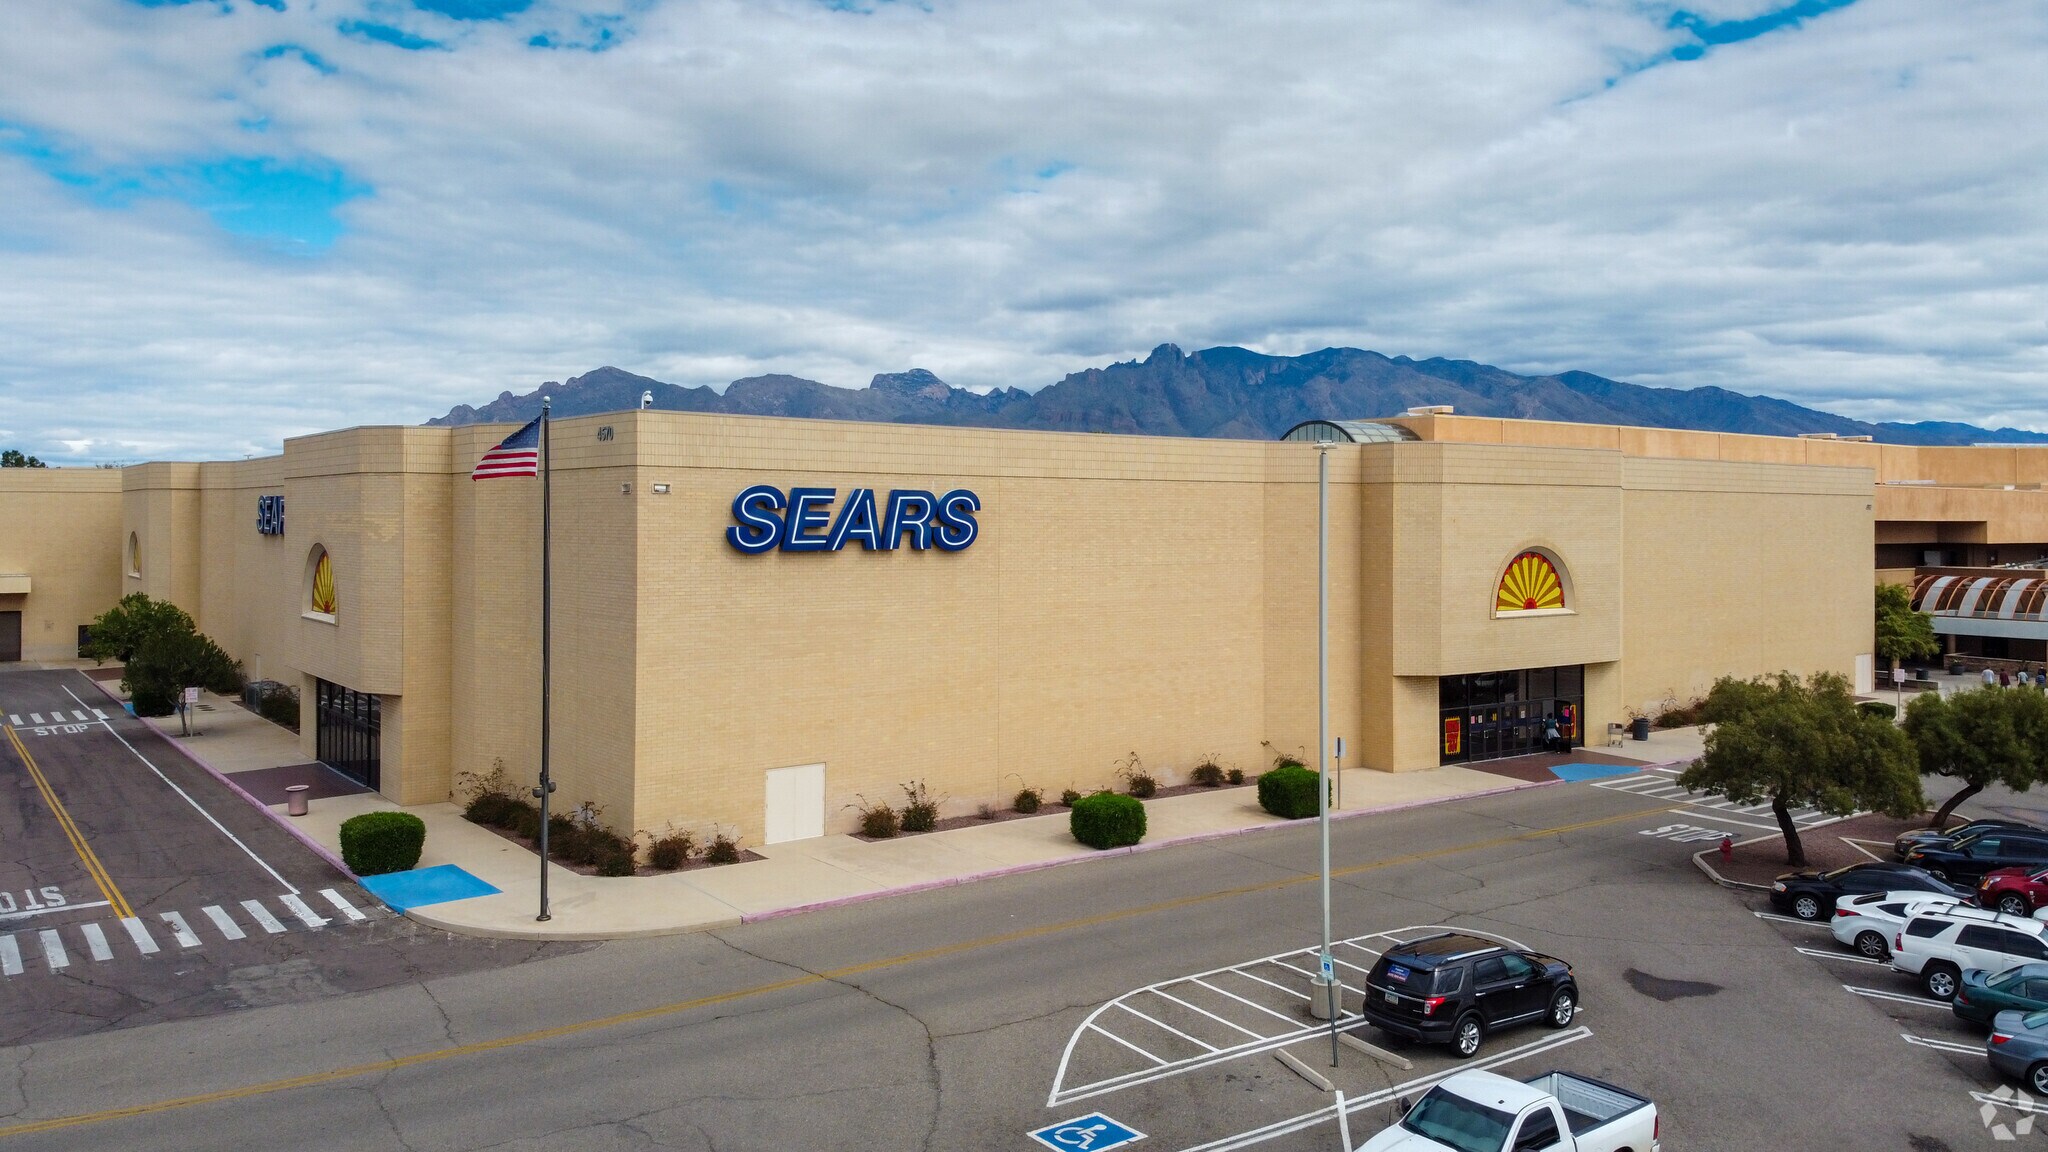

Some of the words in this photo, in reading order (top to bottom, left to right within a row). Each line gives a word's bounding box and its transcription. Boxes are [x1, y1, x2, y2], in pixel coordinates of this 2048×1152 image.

[726, 484, 981, 554] SEARS
[34, 724, 89, 736] STOP
[1638, 824, 1733, 843] STOP
[0, 886, 66, 914] STO
